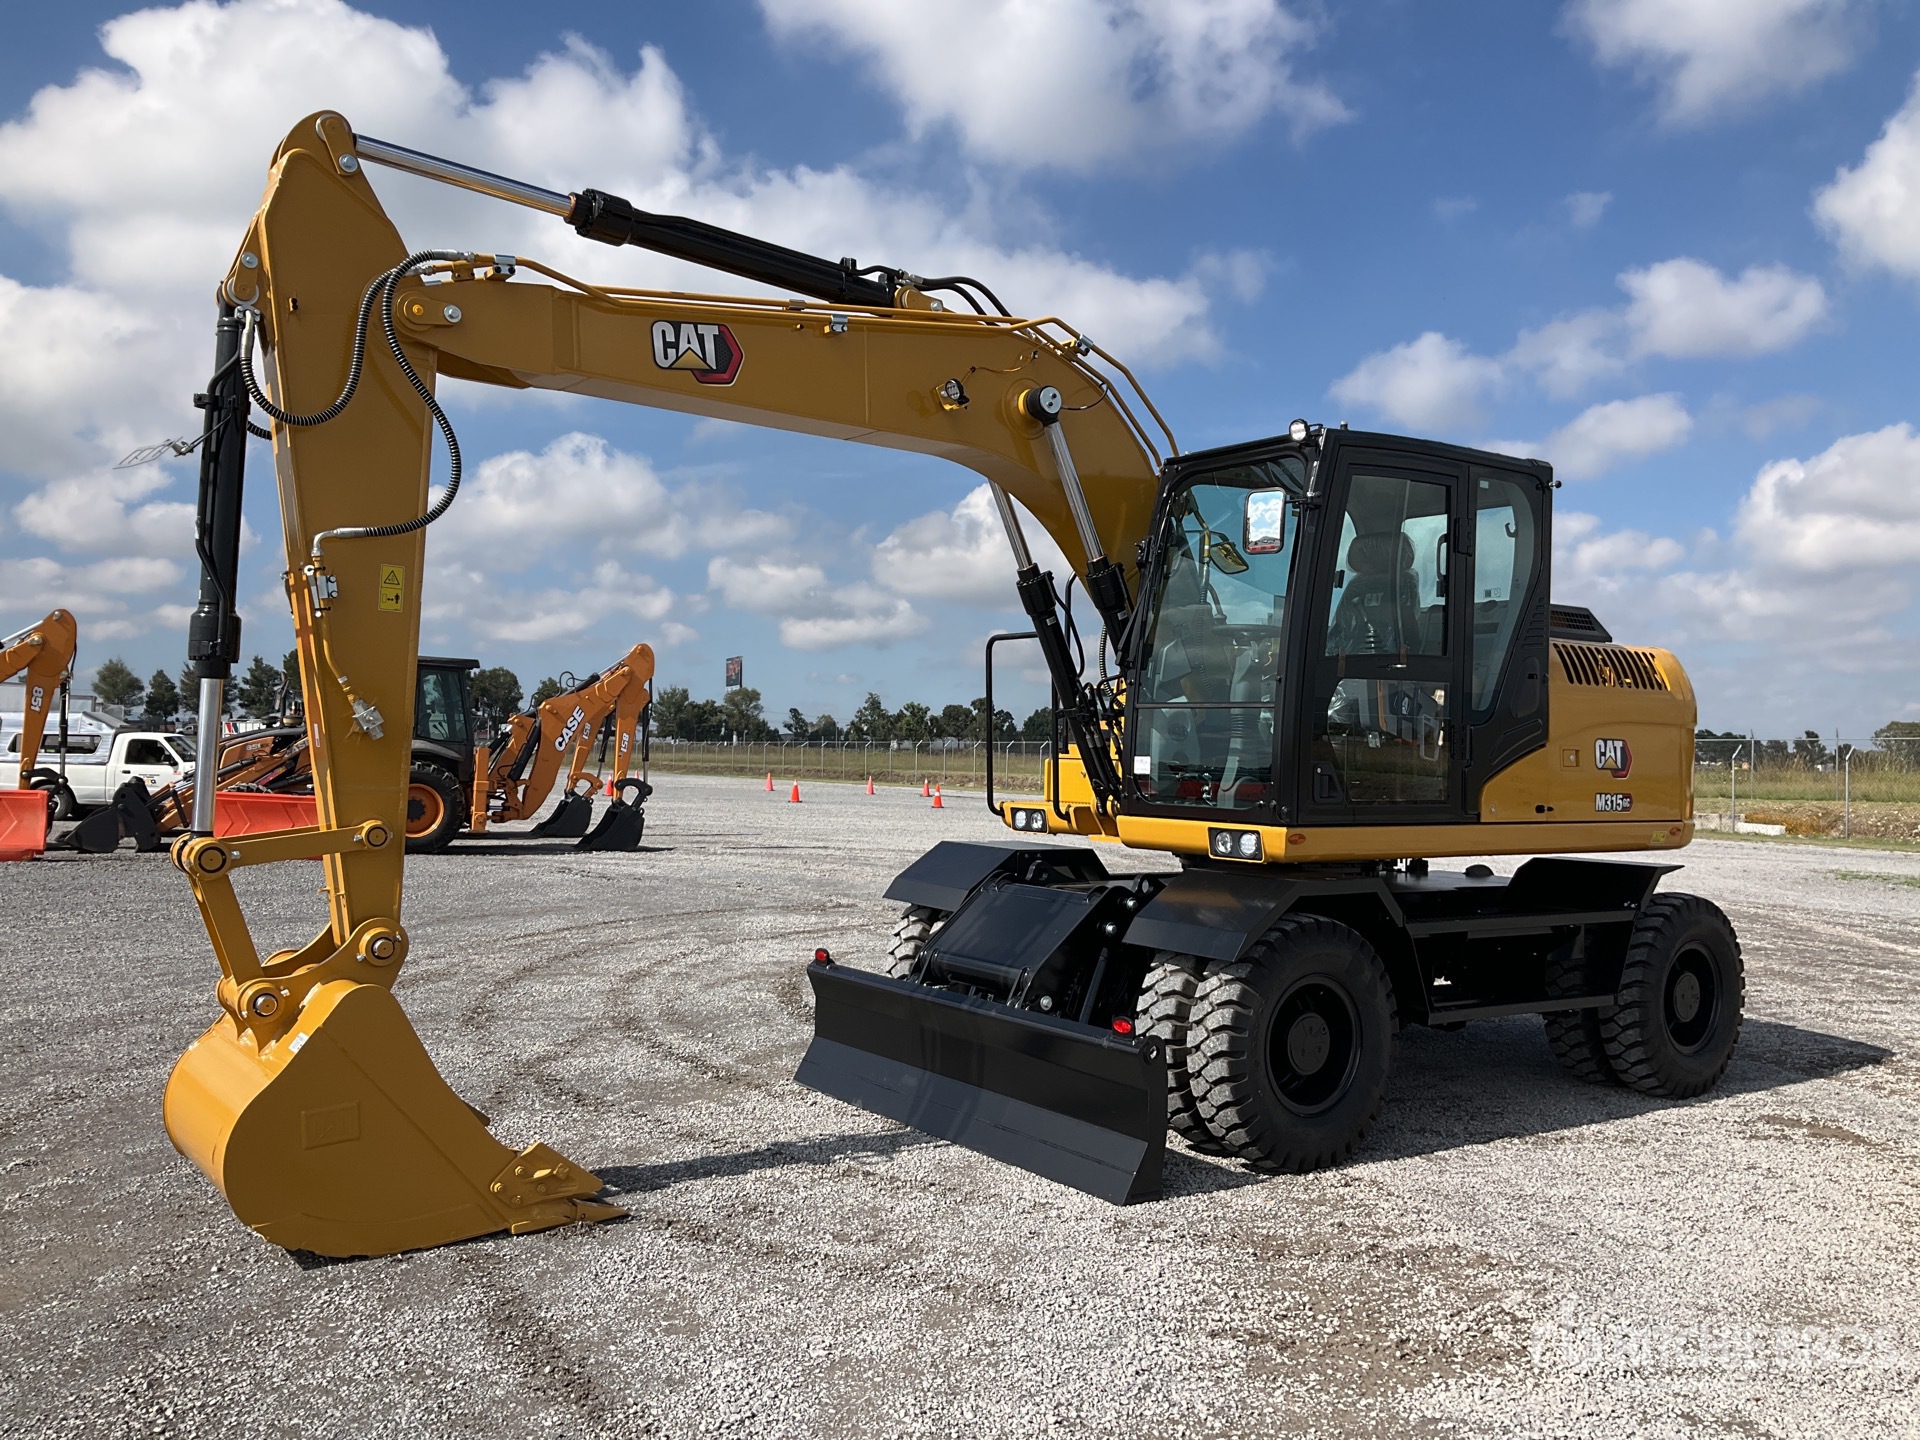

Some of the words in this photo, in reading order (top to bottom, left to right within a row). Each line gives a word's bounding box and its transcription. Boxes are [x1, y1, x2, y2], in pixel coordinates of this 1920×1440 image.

[652, 321, 719, 370] CAT
[1365, 592, 1384, 607] CAT
[31, 686, 44, 712] 851
[555, 706, 585, 752] CASE
[246, 743, 261, 751] 851
[620, 732, 630, 753] 851
[1595, 739, 1623, 769] CAT
[1595, 793, 1623, 812] M315
